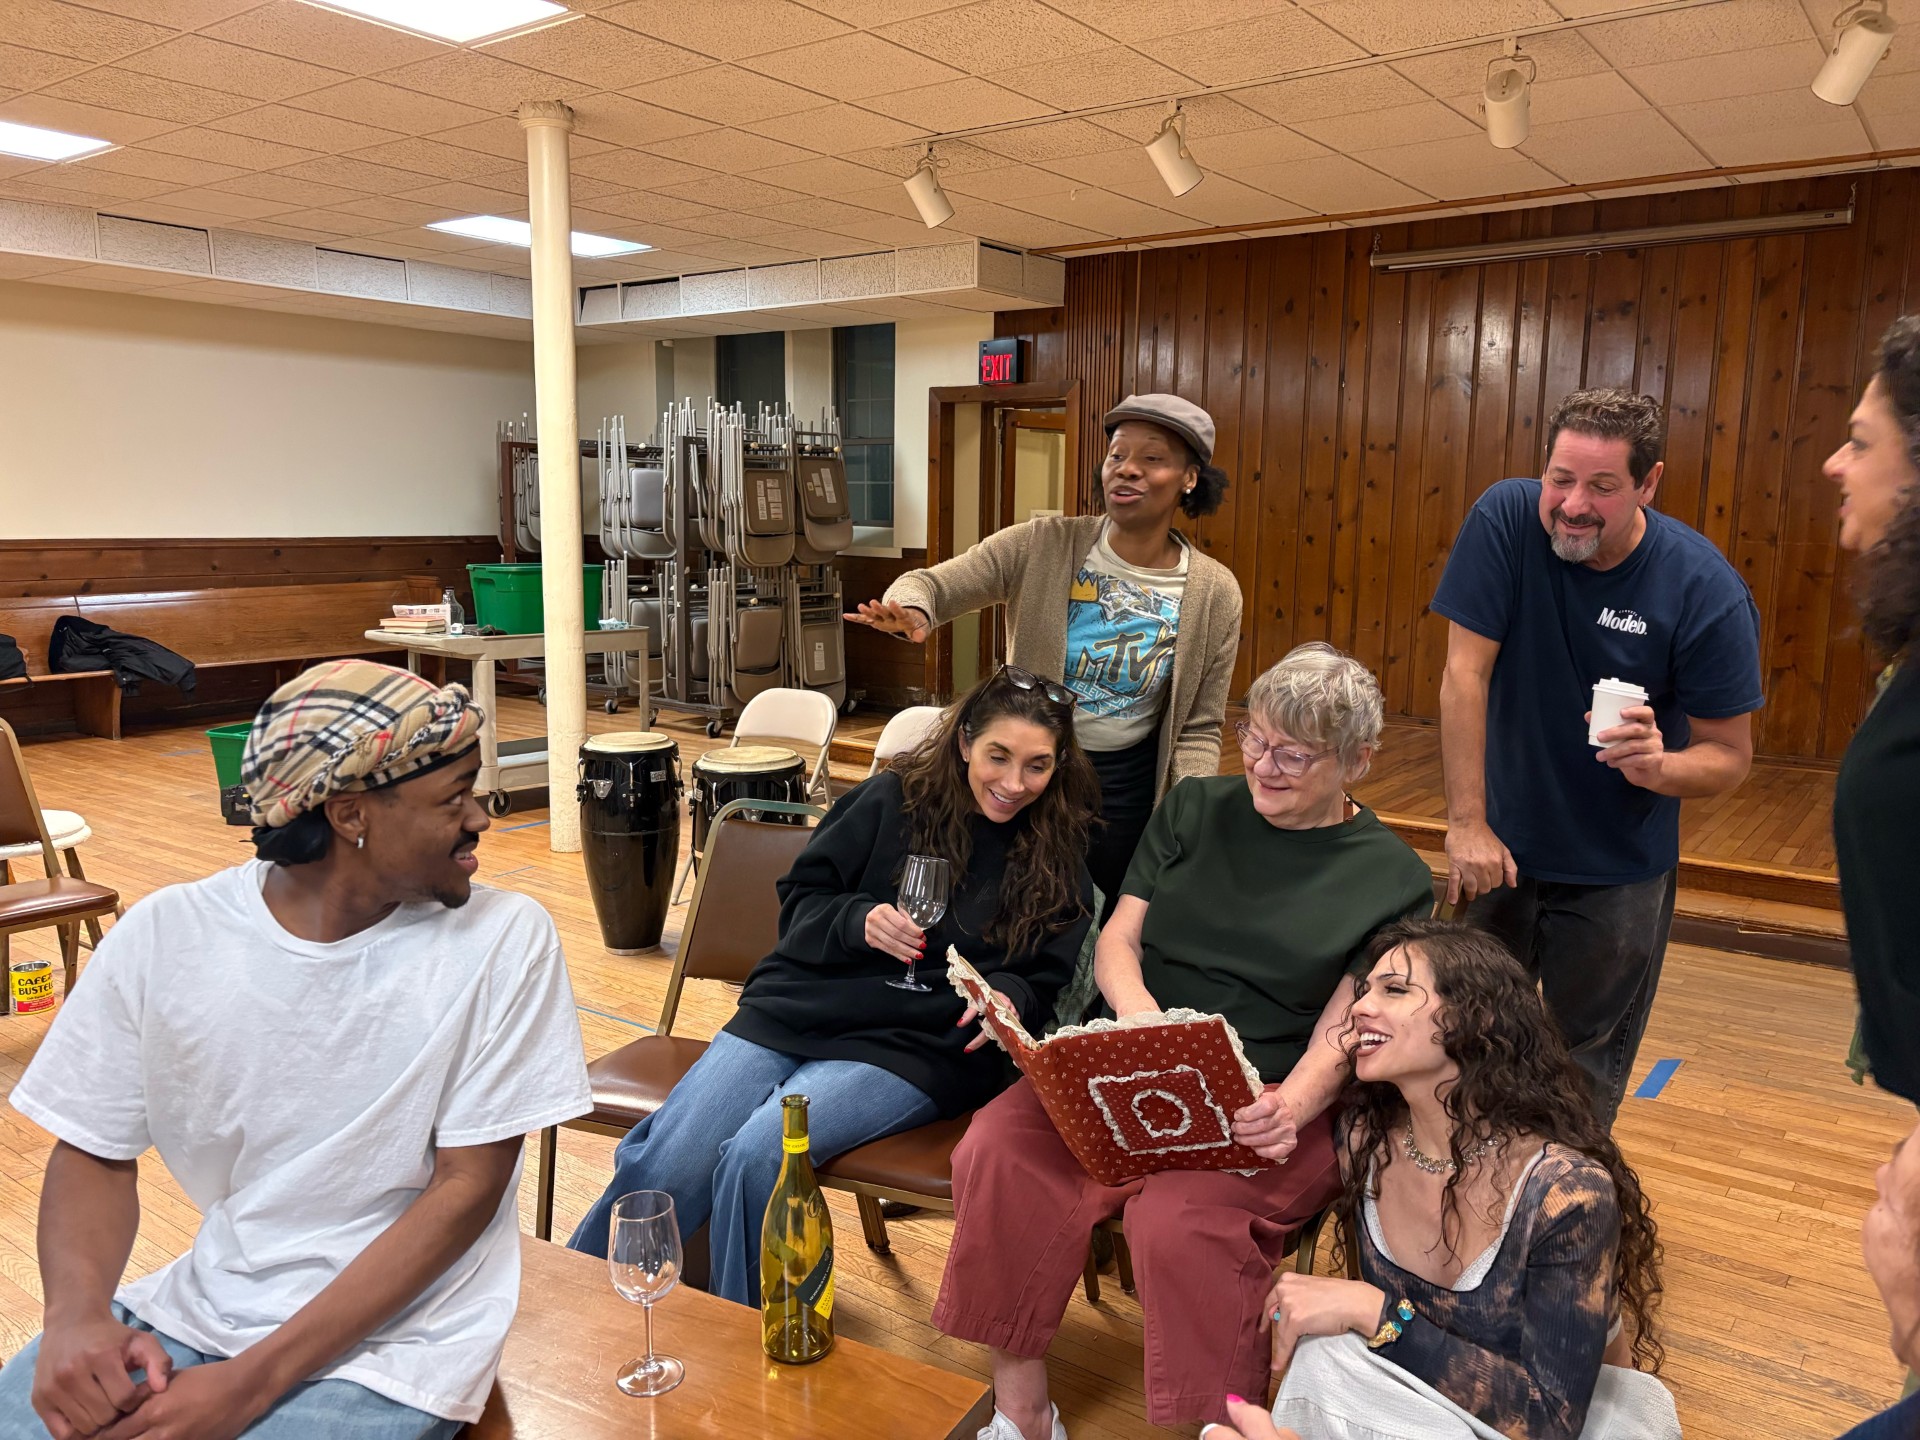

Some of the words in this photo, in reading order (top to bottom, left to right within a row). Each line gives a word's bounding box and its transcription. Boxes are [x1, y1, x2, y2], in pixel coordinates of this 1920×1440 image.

[982, 354, 1013, 382] EXIT
[1075, 629, 1177, 686] MTV
[1072, 680, 1129, 708] TELEVION
